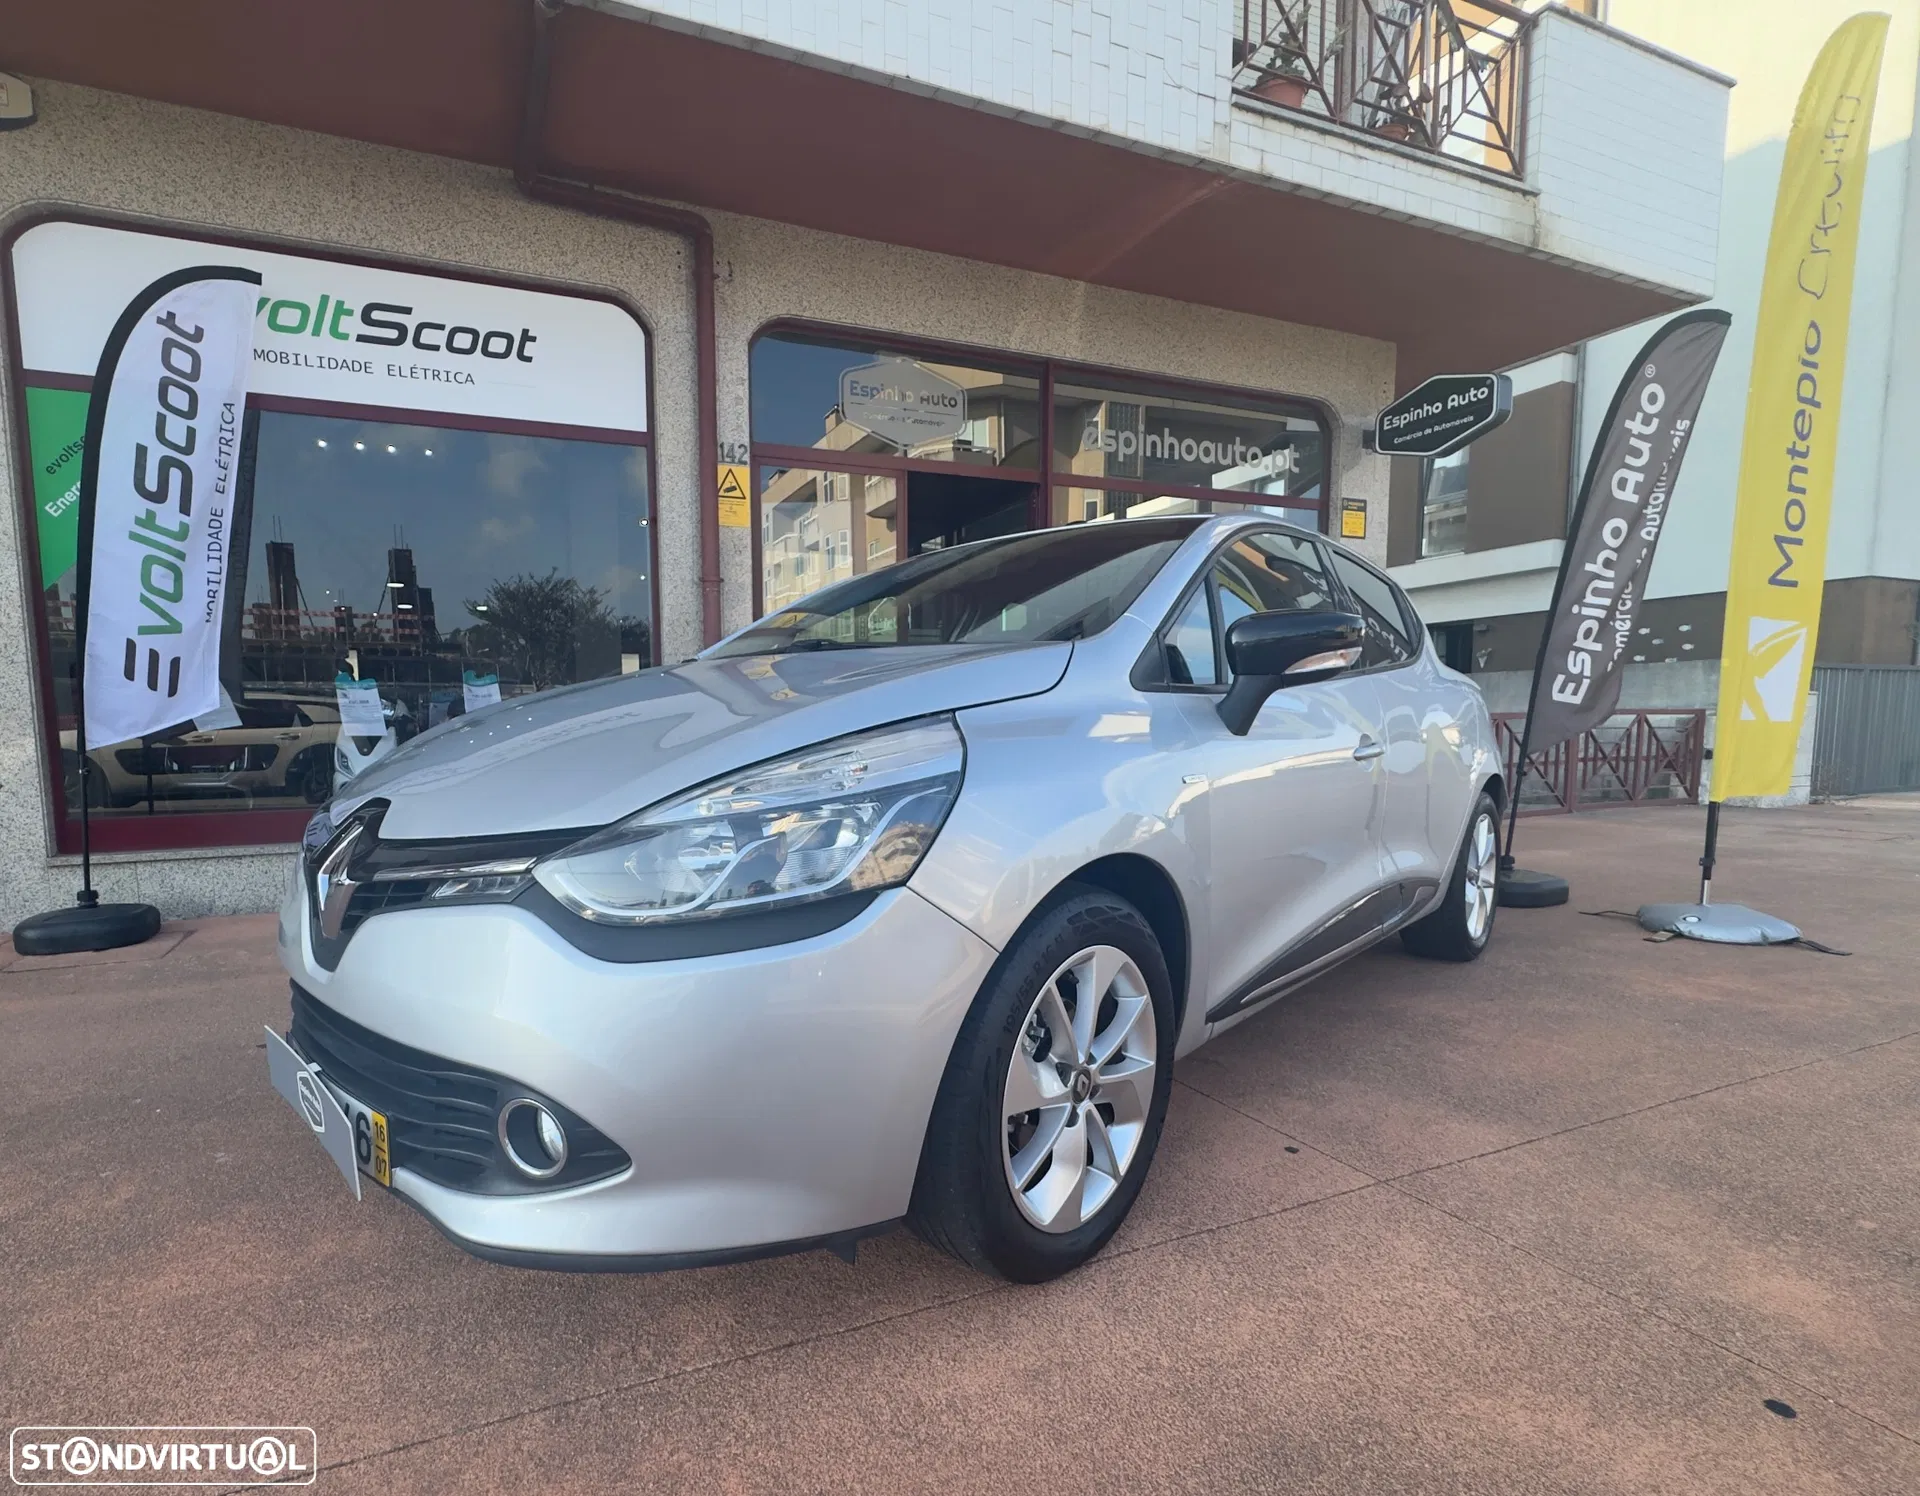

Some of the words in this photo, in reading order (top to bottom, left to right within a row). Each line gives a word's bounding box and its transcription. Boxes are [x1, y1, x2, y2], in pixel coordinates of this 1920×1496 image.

[256, 294, 537, 363] oltScoot
[253, 348, 374, 375] MOBILIDADE
[387, 364, 475, 385] ELÉTRICA
[849, 380, 914, 402] Espinho
[919, 389, 958, 409] Auto
[1383, 402, 1443, 430] Espinho
[1447, 386, 1489, 410] Auto
[215, 402, 236, 495] ELÉTRICA
[1393, 430, 1423, 444] Comércio
[1423, 427, 1433, 435] de
[1433, 415, 1475, 433] Automóveis
[719, 442, 748, 465] 142
[1081, 425, 1301, 479] espinhoauto.pt
[1767, 320, 1822, 588] Montepio
[44, 480, 81, 518] Ener
[1640, 419, 1691, 541] Automeis
[124, 310, 205, 698] EvoltScoot
[1551, 517, 1629, 705] Espinho
[1611, 382, 1666, 504] Auto
[374, 1120, 386, 1143] 16
[375, 1154, 387, 1177] 07
